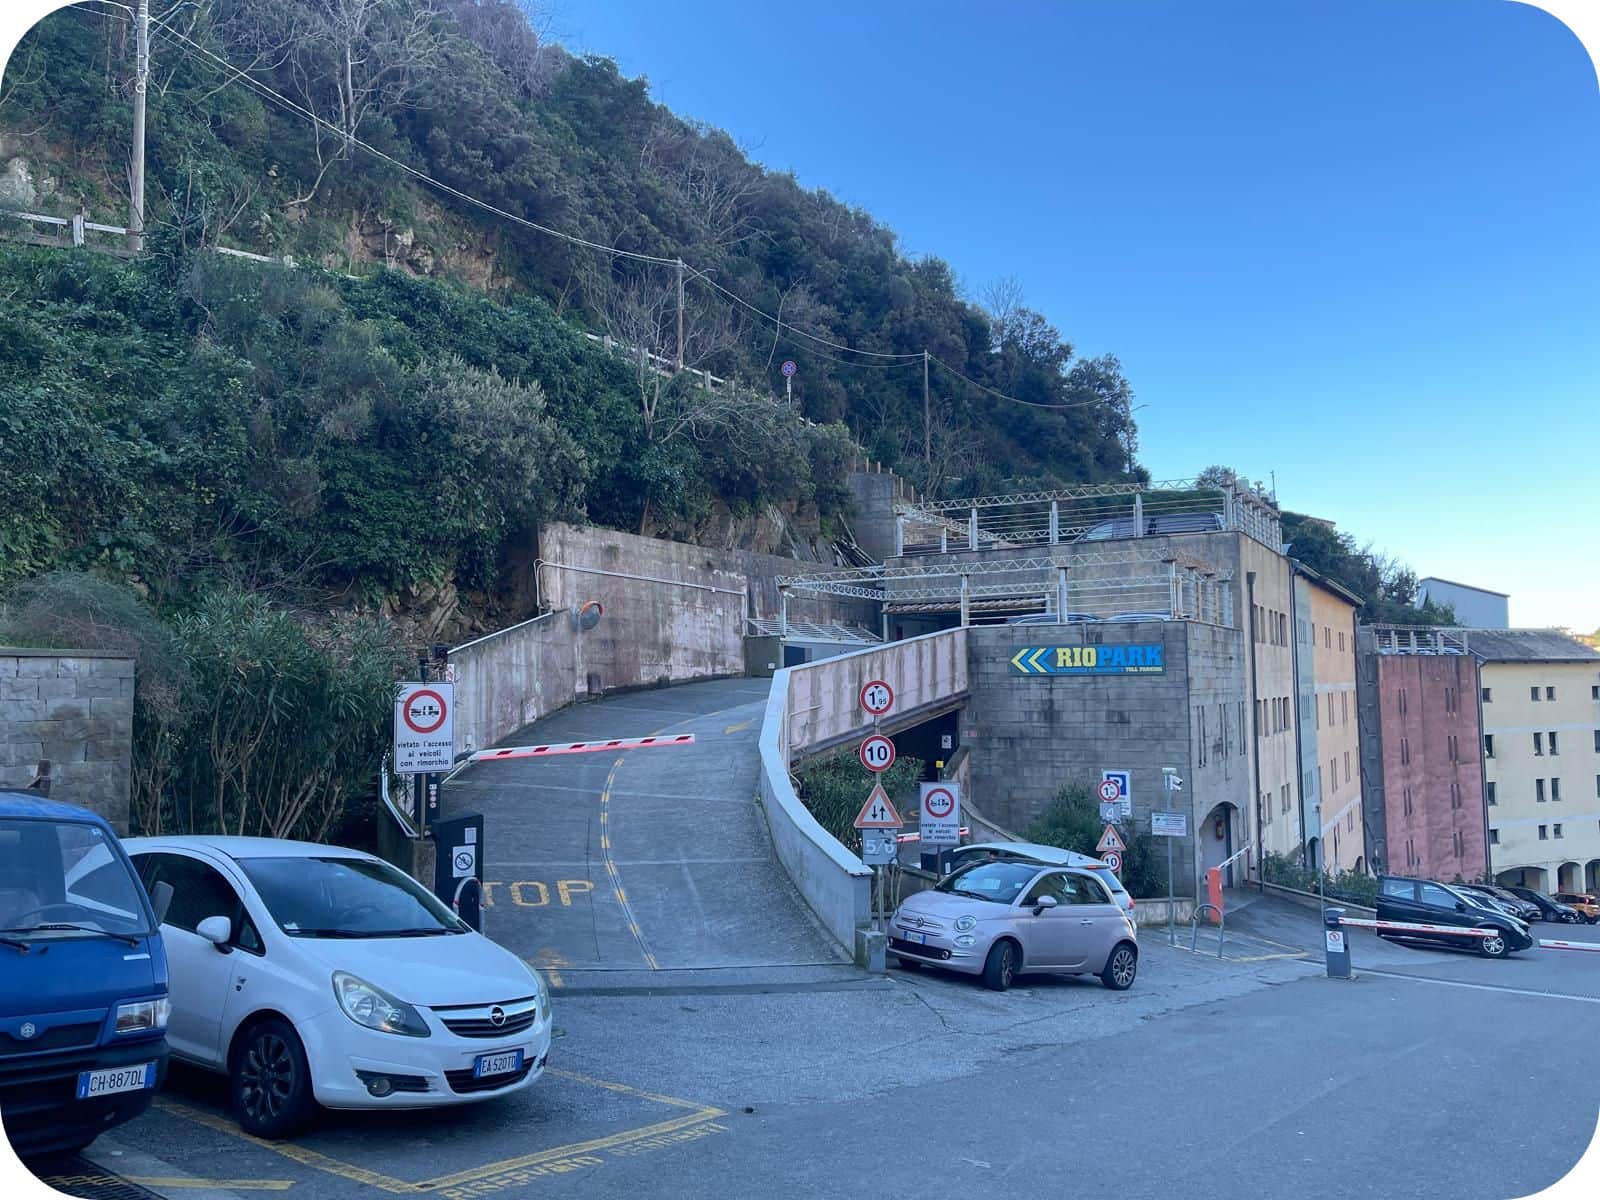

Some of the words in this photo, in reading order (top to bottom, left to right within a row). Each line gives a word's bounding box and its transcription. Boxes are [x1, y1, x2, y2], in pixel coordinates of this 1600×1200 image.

[867, 746, 887, 761] 10
[417, 759, 449, 767] rimorchio
[1106, 807, 1114, 820] 4
[482, 880, 594, 907] TOP
[481, 1059, 491, 1073] EA
[108, 1070, 144, 1089] 887DL
